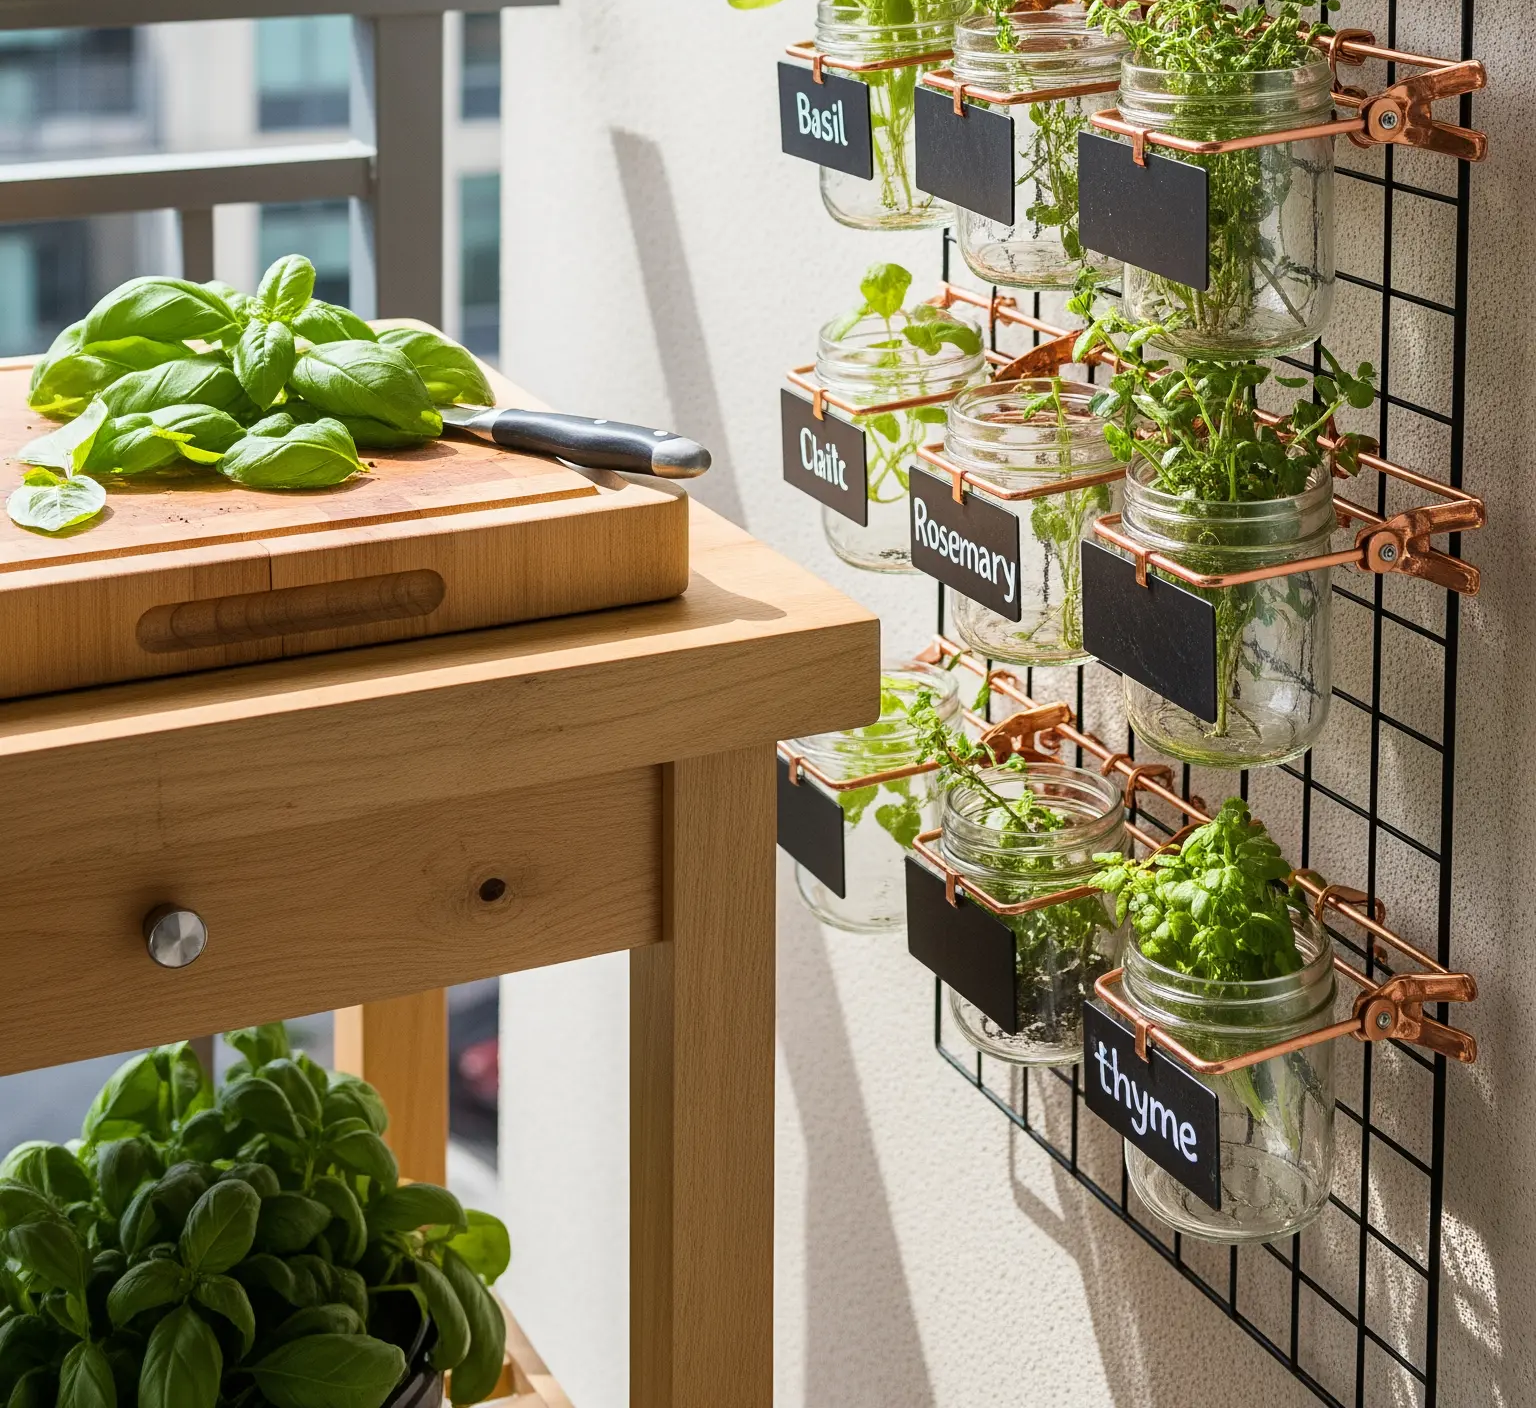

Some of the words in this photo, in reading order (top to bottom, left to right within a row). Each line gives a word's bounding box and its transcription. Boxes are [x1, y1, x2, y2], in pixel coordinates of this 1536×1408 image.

[796, 92, 849, 147] Basil
[913, 496, 1017, 605] Rosemary
[1093, 1041, 1198, 1163] thyme
